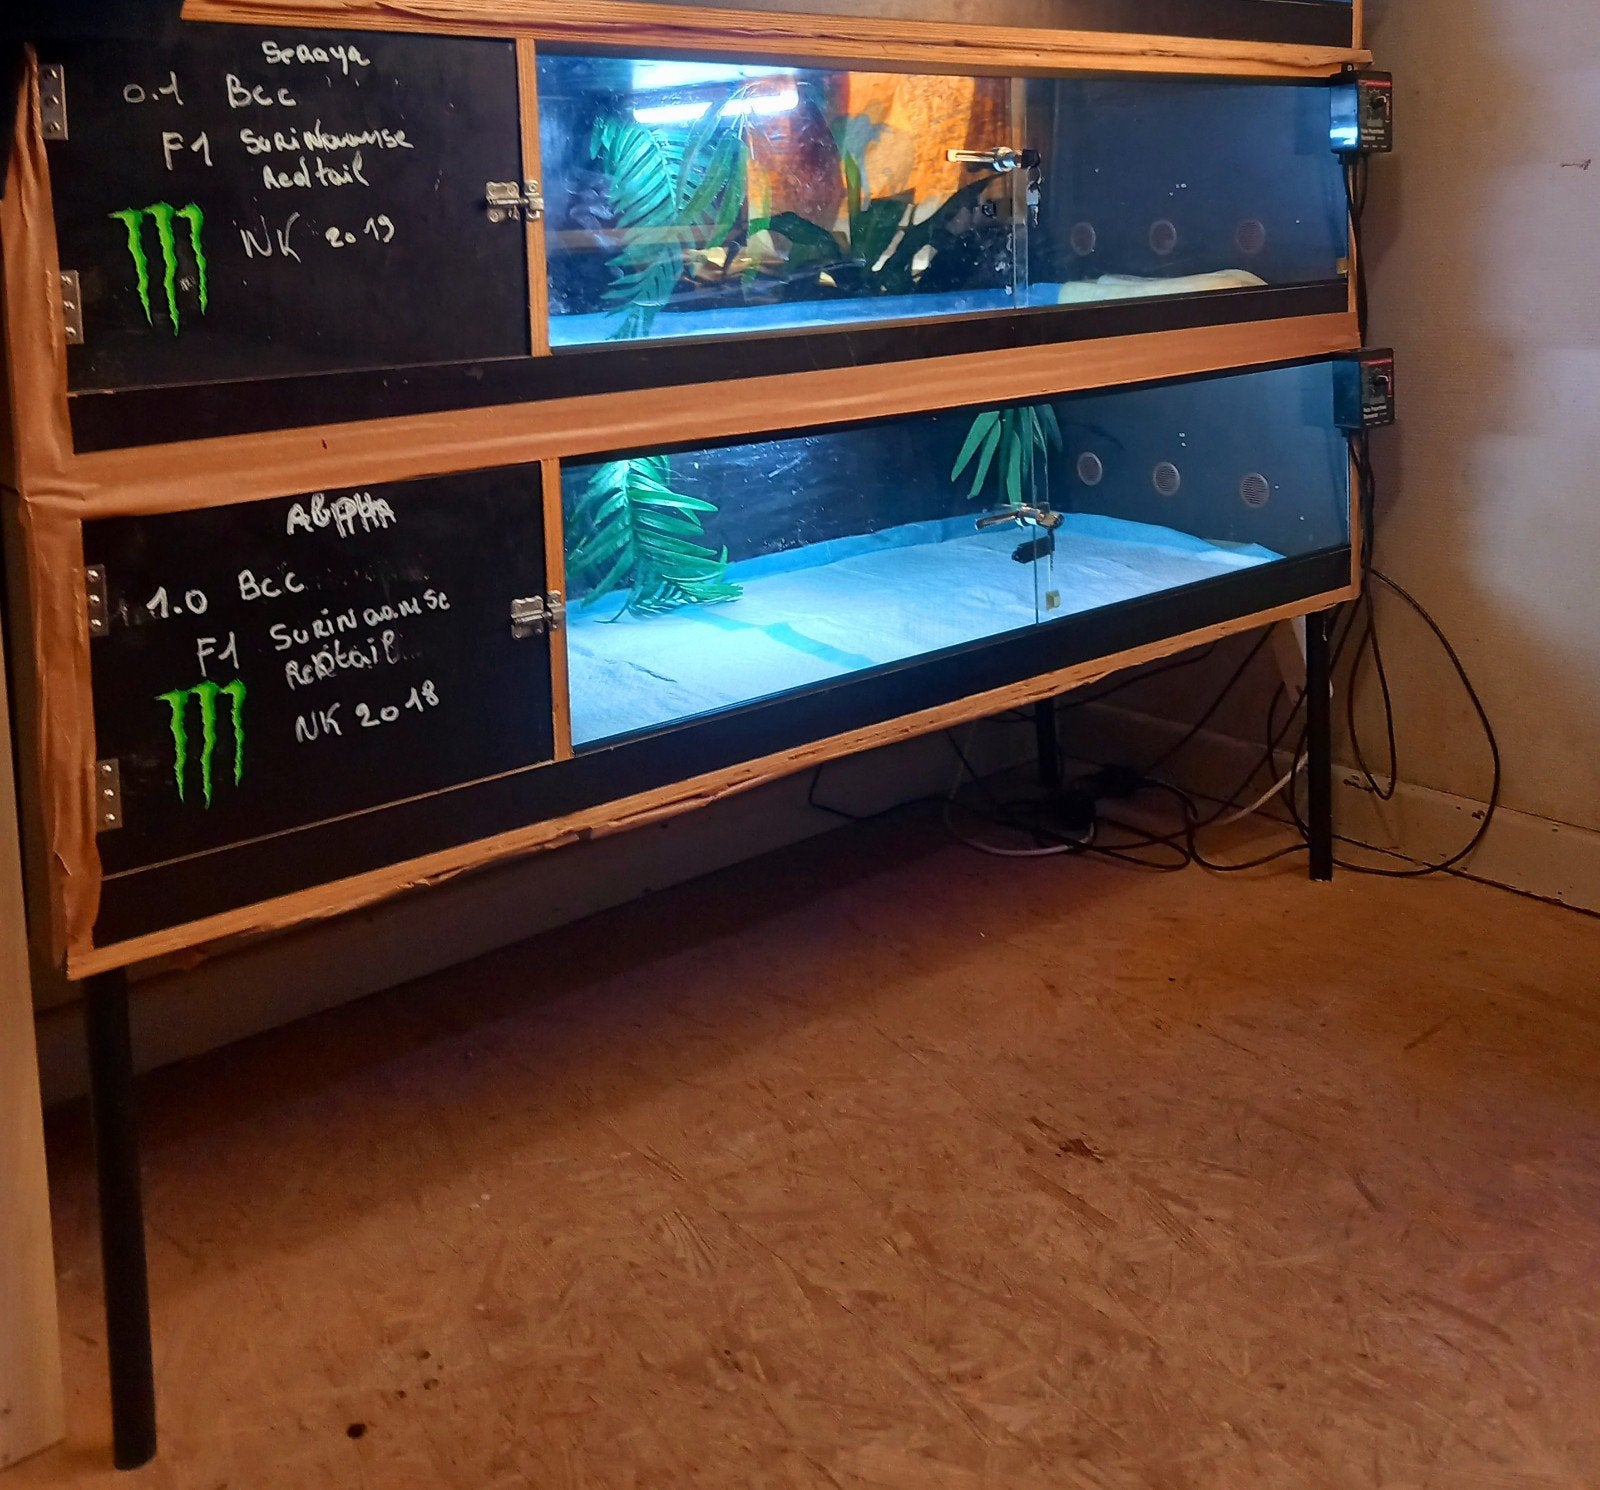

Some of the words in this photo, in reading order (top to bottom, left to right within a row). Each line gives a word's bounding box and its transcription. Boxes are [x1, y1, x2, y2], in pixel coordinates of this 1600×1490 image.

[162, 131, 213, 171] F1
[146, 586, 208, 619] 1.0
[197, 631, 240, 677] F1
[295, 702, 342, 743] NK
